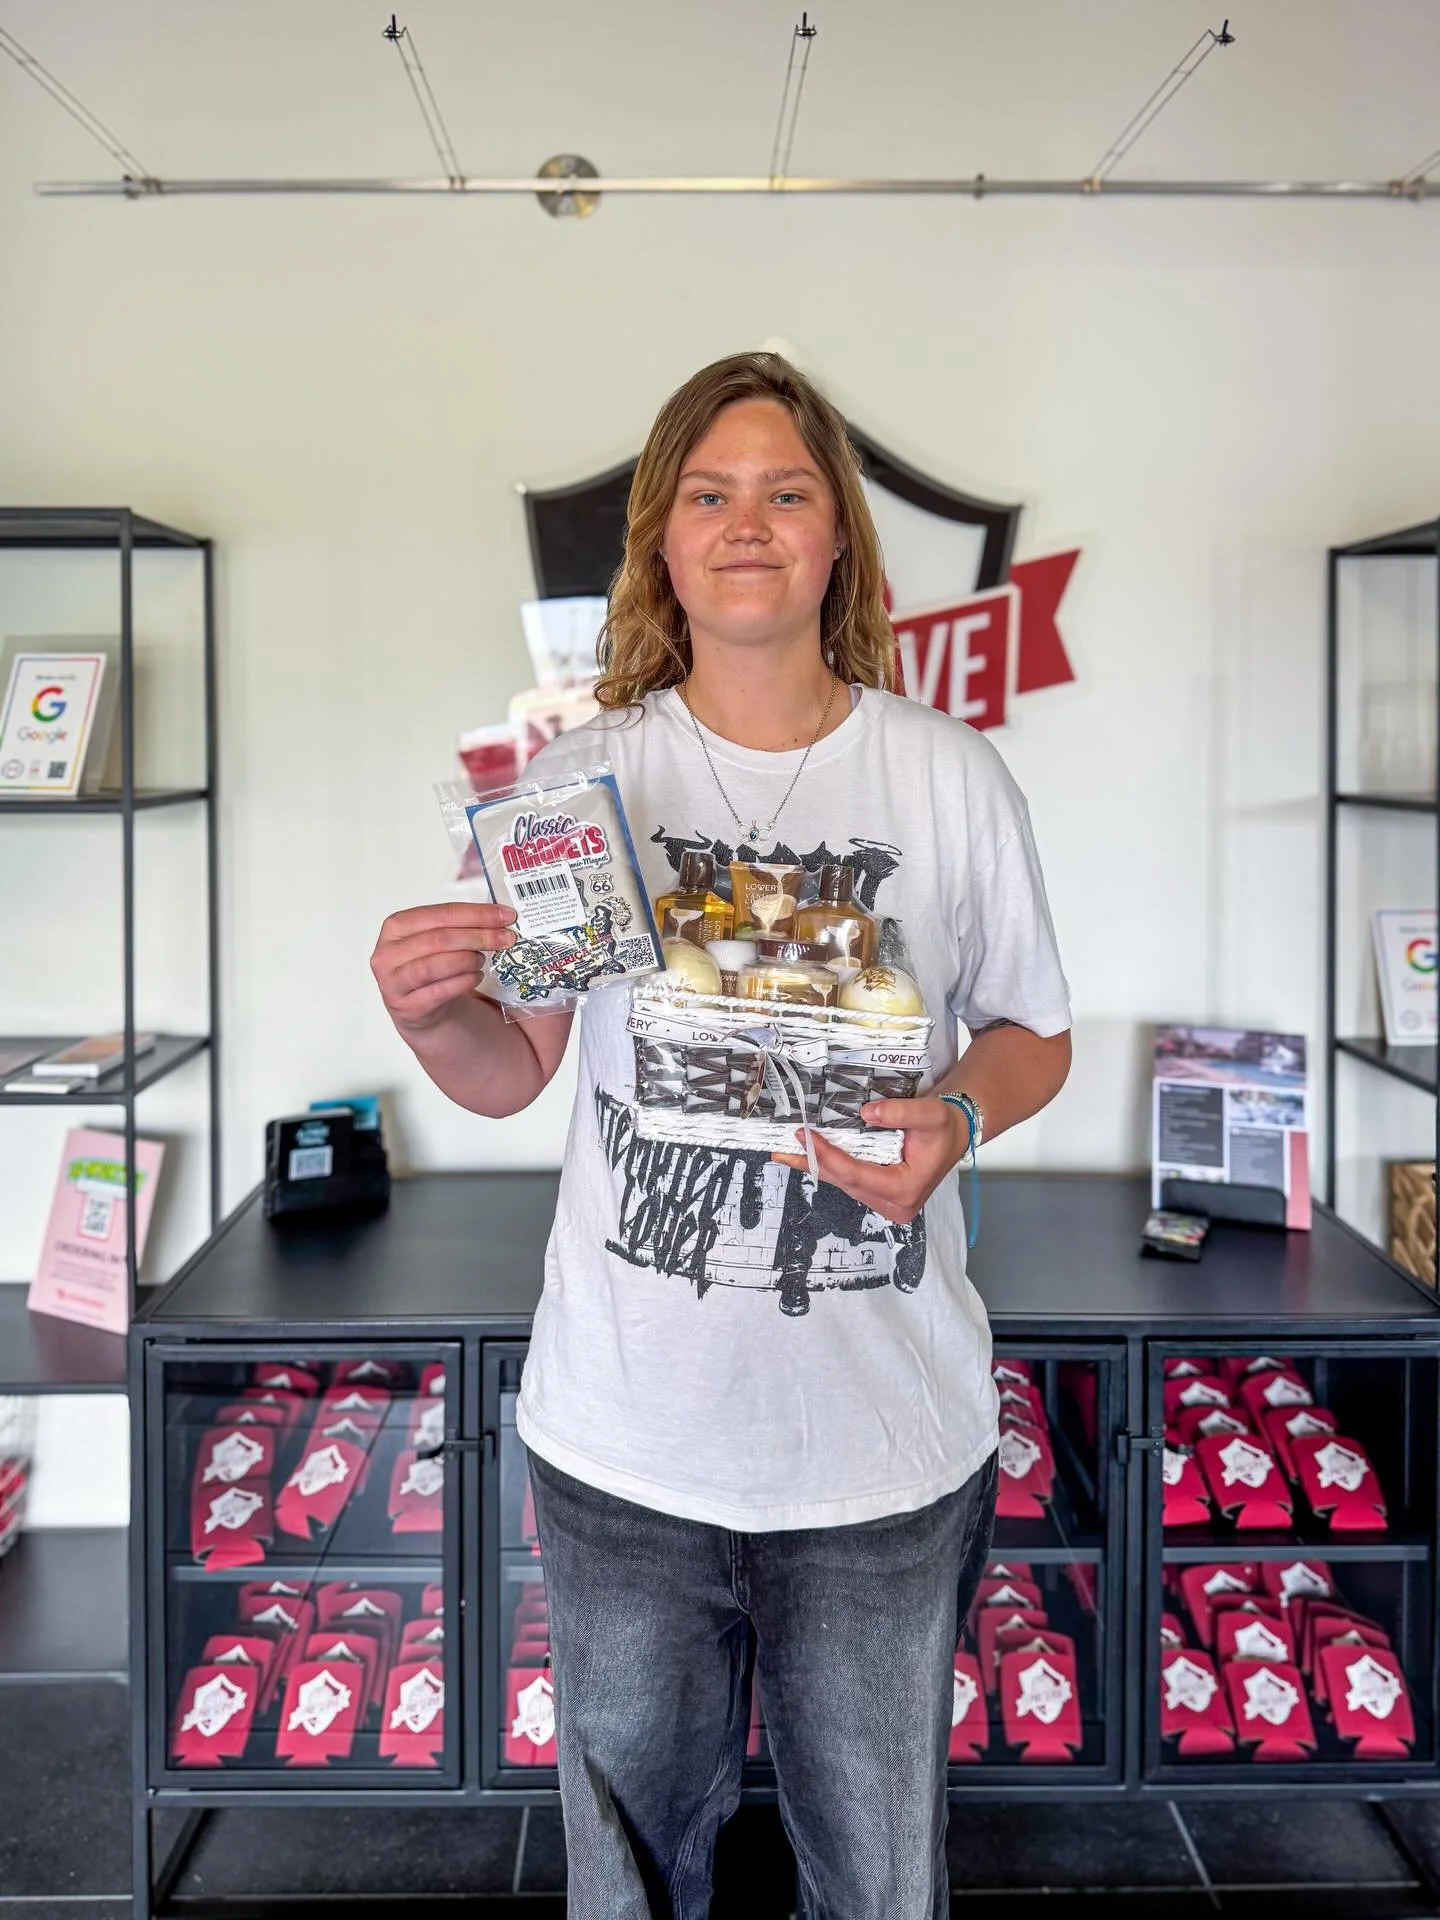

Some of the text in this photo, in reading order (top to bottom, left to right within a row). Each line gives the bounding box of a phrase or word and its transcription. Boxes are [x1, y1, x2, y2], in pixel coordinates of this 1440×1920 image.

[17, 726, 68, 744] Google
[513, 814, 575, 847] Classic
[502, 826, 605, 873] MAGNETS
[592, 880, 611, 892] 66
[539, 947, 591, 974] AMERICA
[870, 1053, 923, 1065] LOVERY
